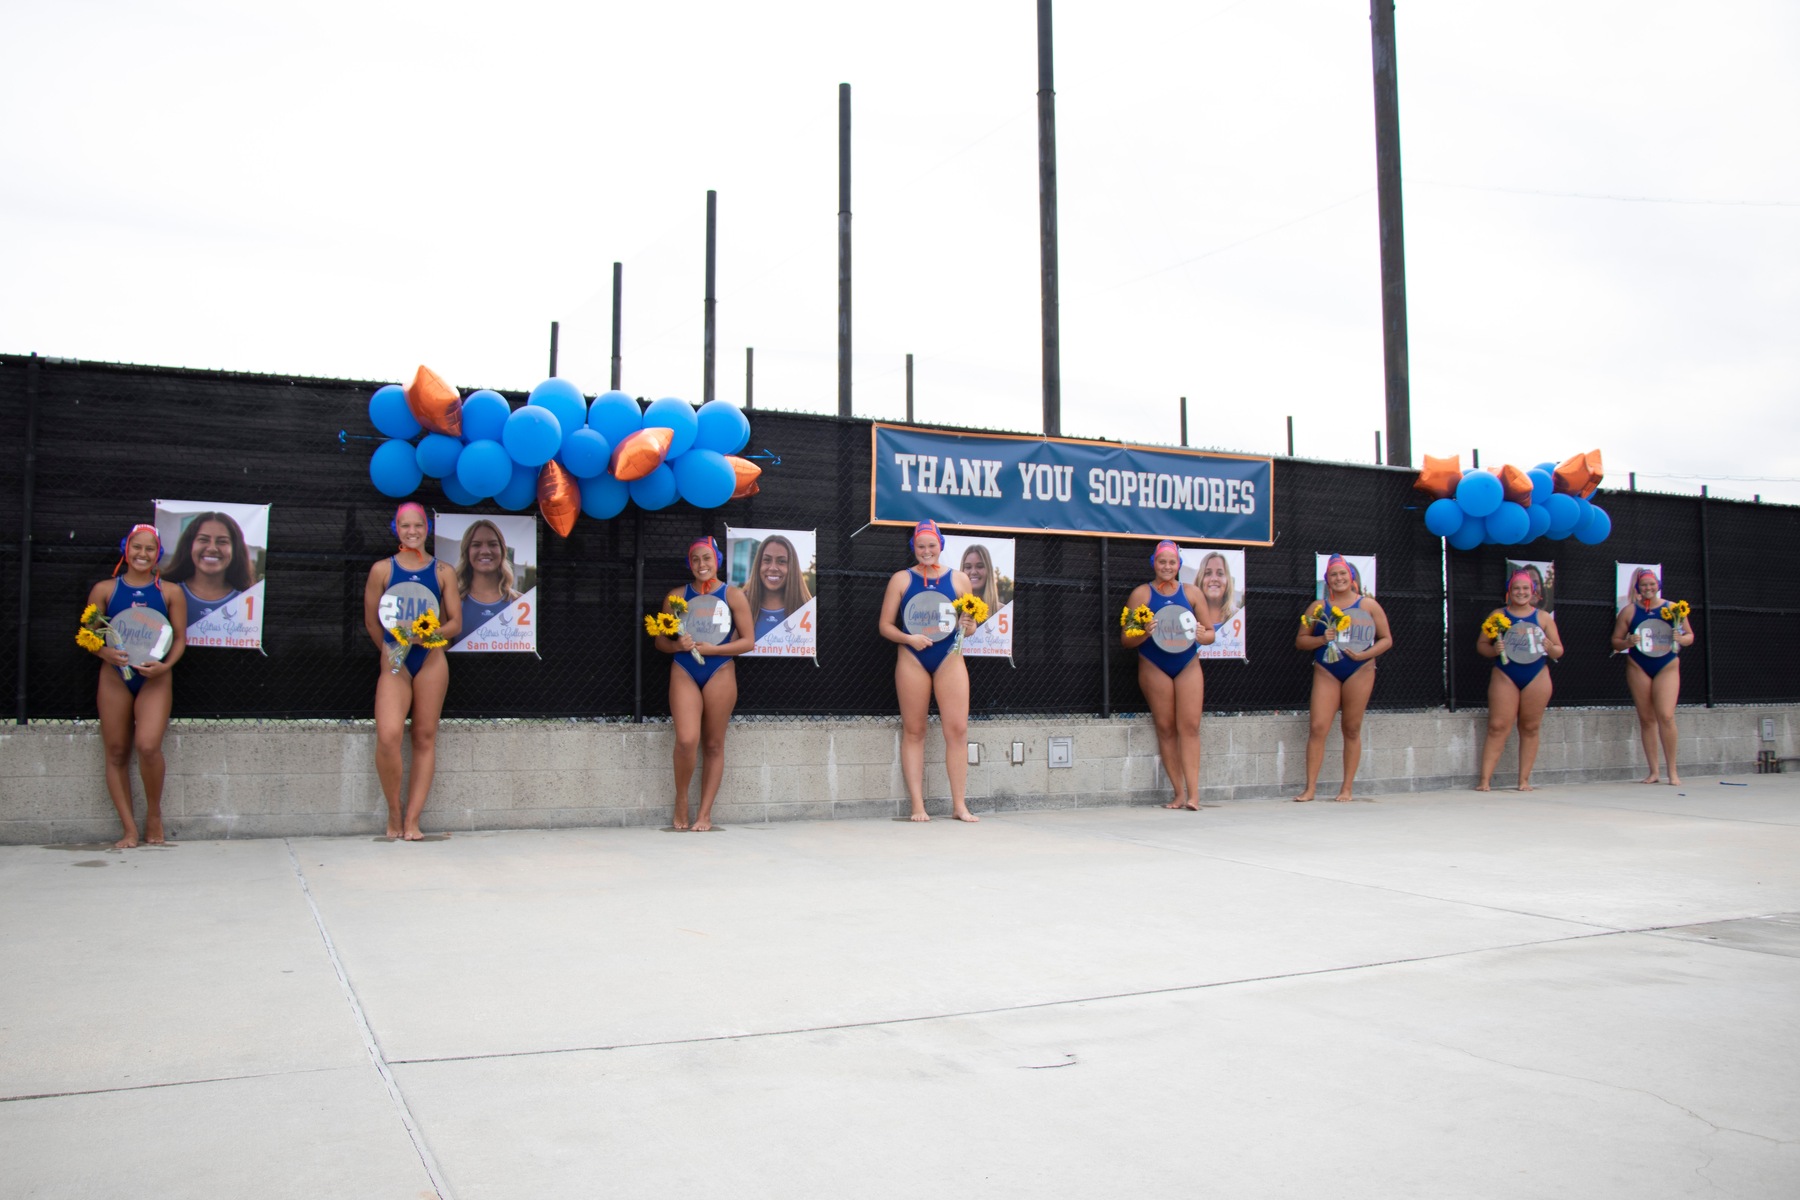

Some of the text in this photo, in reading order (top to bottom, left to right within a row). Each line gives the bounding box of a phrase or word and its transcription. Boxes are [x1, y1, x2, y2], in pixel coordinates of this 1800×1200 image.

[895, 453, 1256, 515] THANK YOU SOPHOMORES
[245, 596, 255, 621] 1
[396, 596, 428, 621] SAM
[516, 602, 531, 626] 2
[712, 600, 731, 633] 4
[938, 602, 957, 633] 5
[195, 619, 260, 637] Citrus College
[799, 610, 812, 633] 4
[998, 613, 1009, 635] 5
[1179, 610, 1197, 640] 9
[1232, 618, 1242, 638] 9
[149, 624, 173, 660] 1
[185, 635, 222, 645] ynalee
[466, 640, 531, 650] Sam Godinho
[476, 626, 534, 641] Citrus College
[752, 644, 816, 656] Franny Vargas
